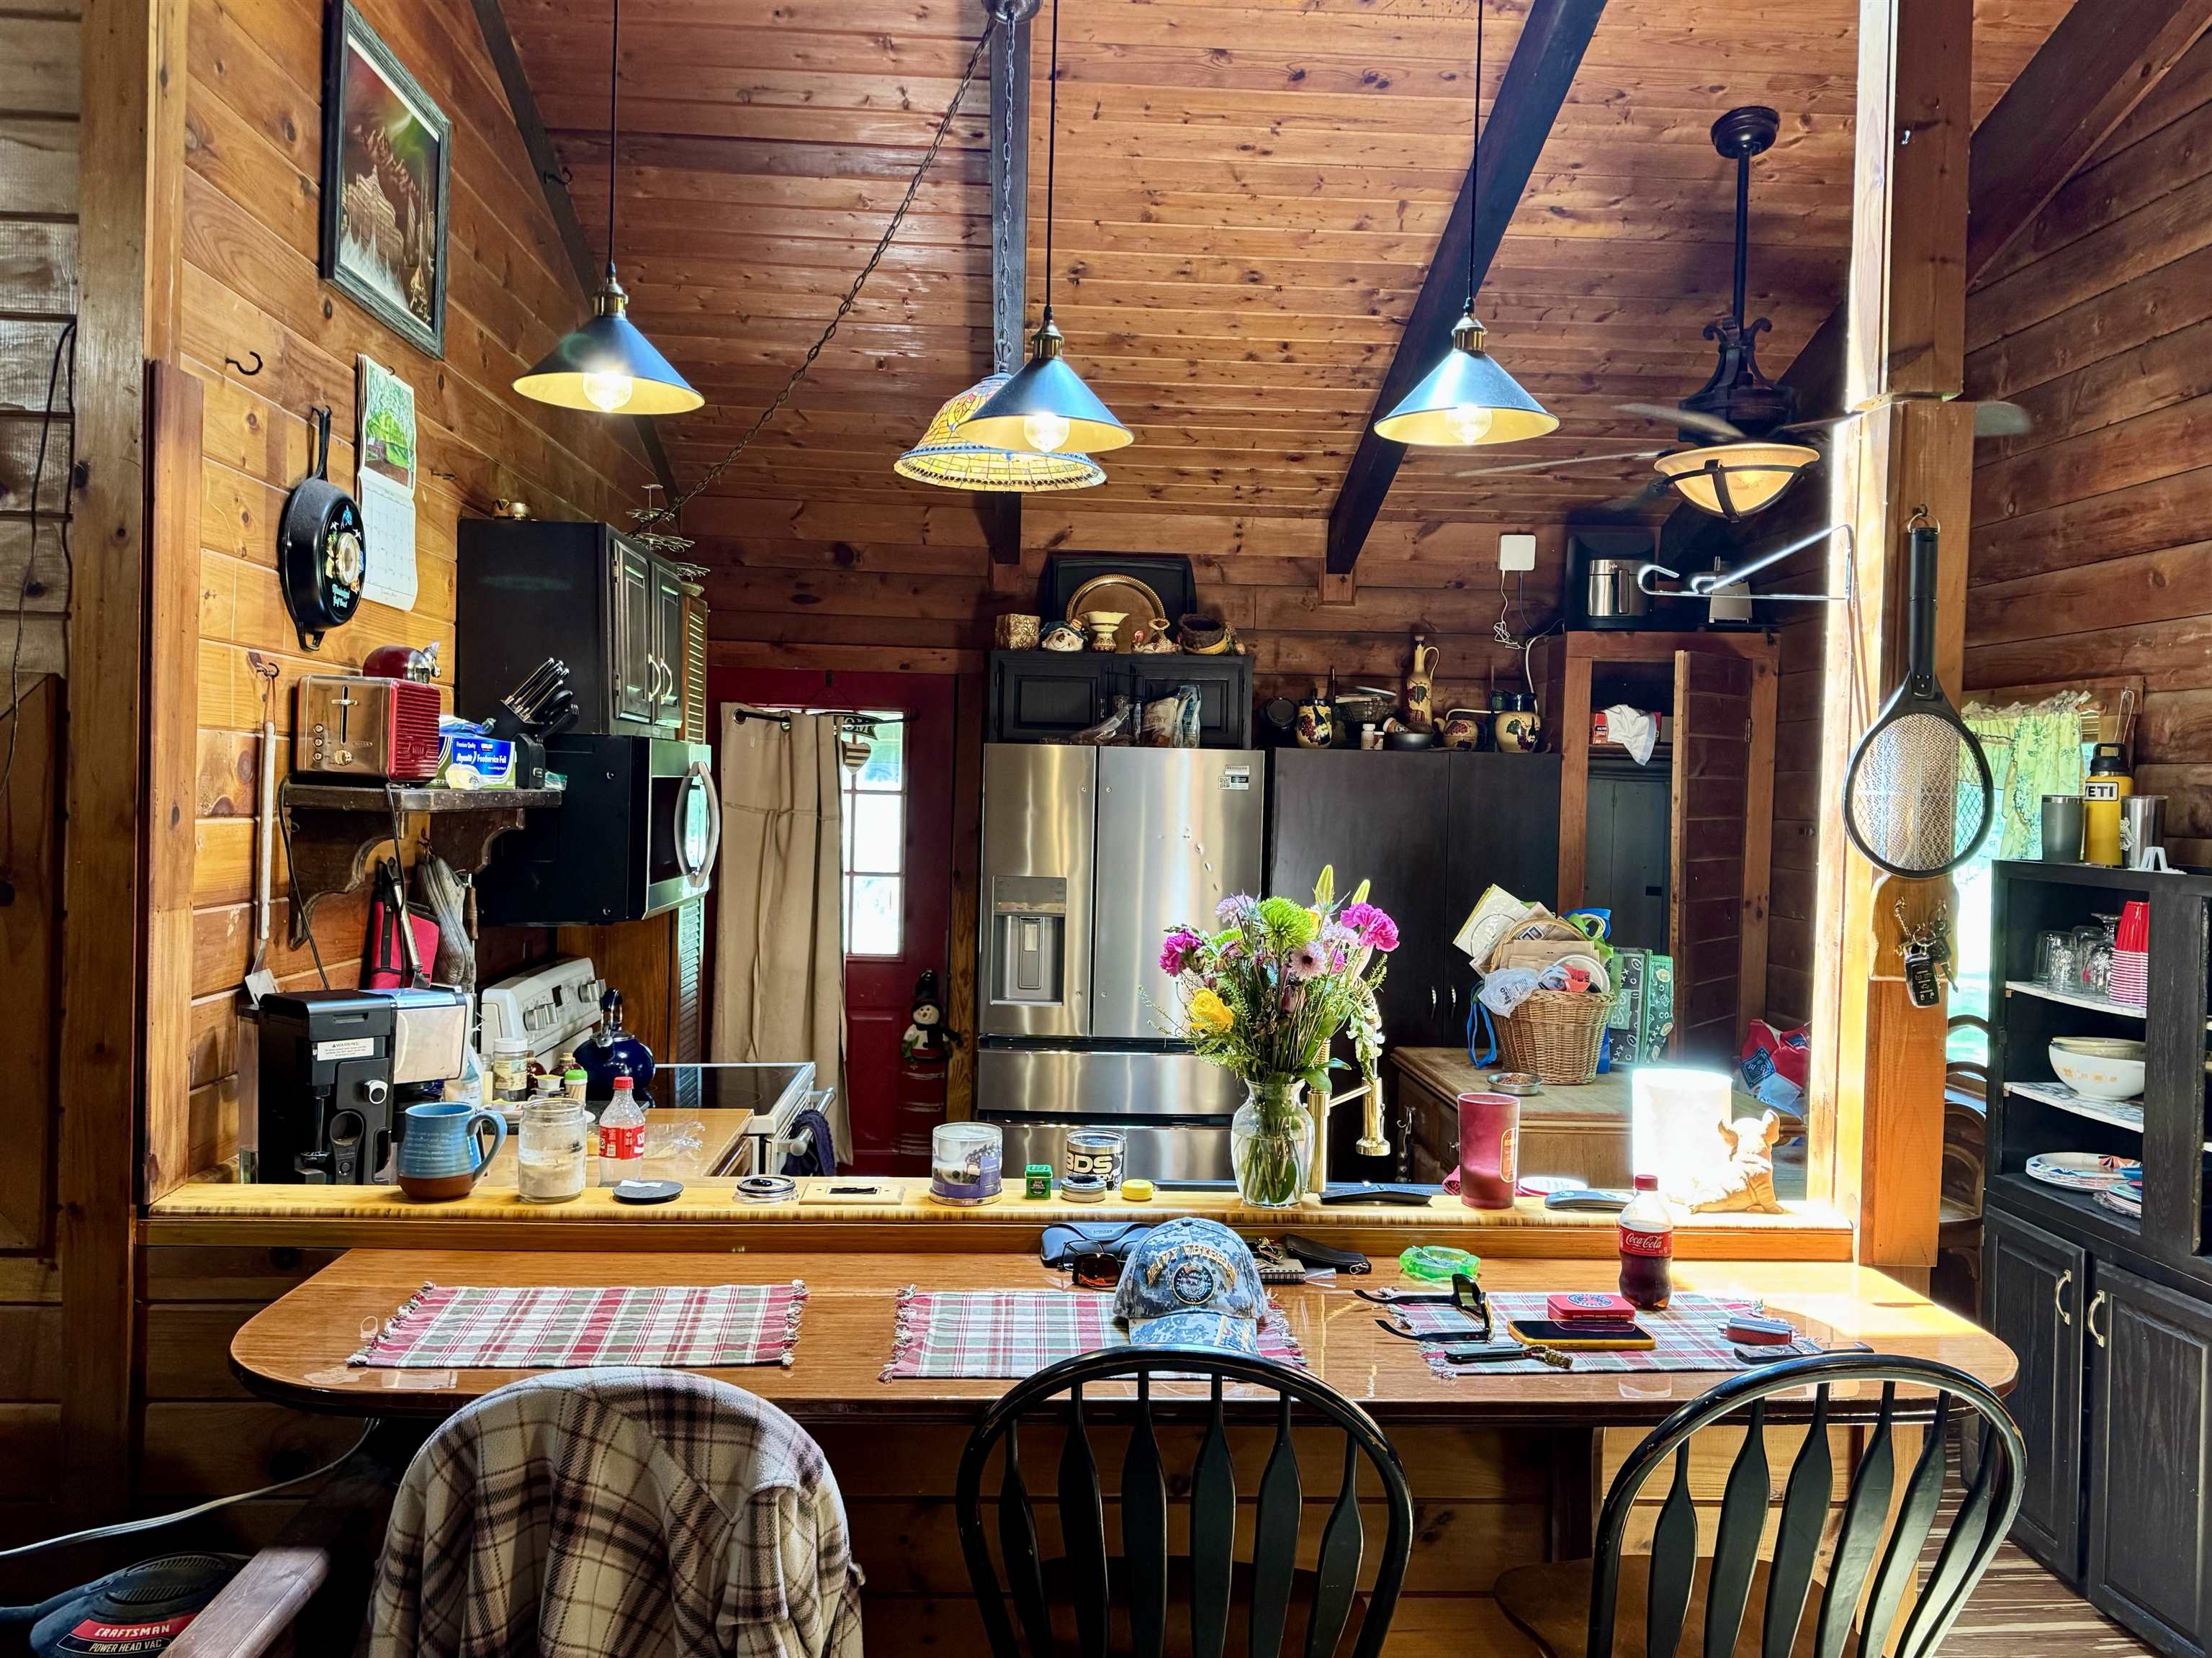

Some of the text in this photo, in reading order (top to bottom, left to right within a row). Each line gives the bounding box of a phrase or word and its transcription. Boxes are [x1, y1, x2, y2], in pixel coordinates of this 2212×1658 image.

[94, 1625, 170, 1638] CRAFTSMAN
[89, 1639, 162, 1653] POWER HEAD VAC
